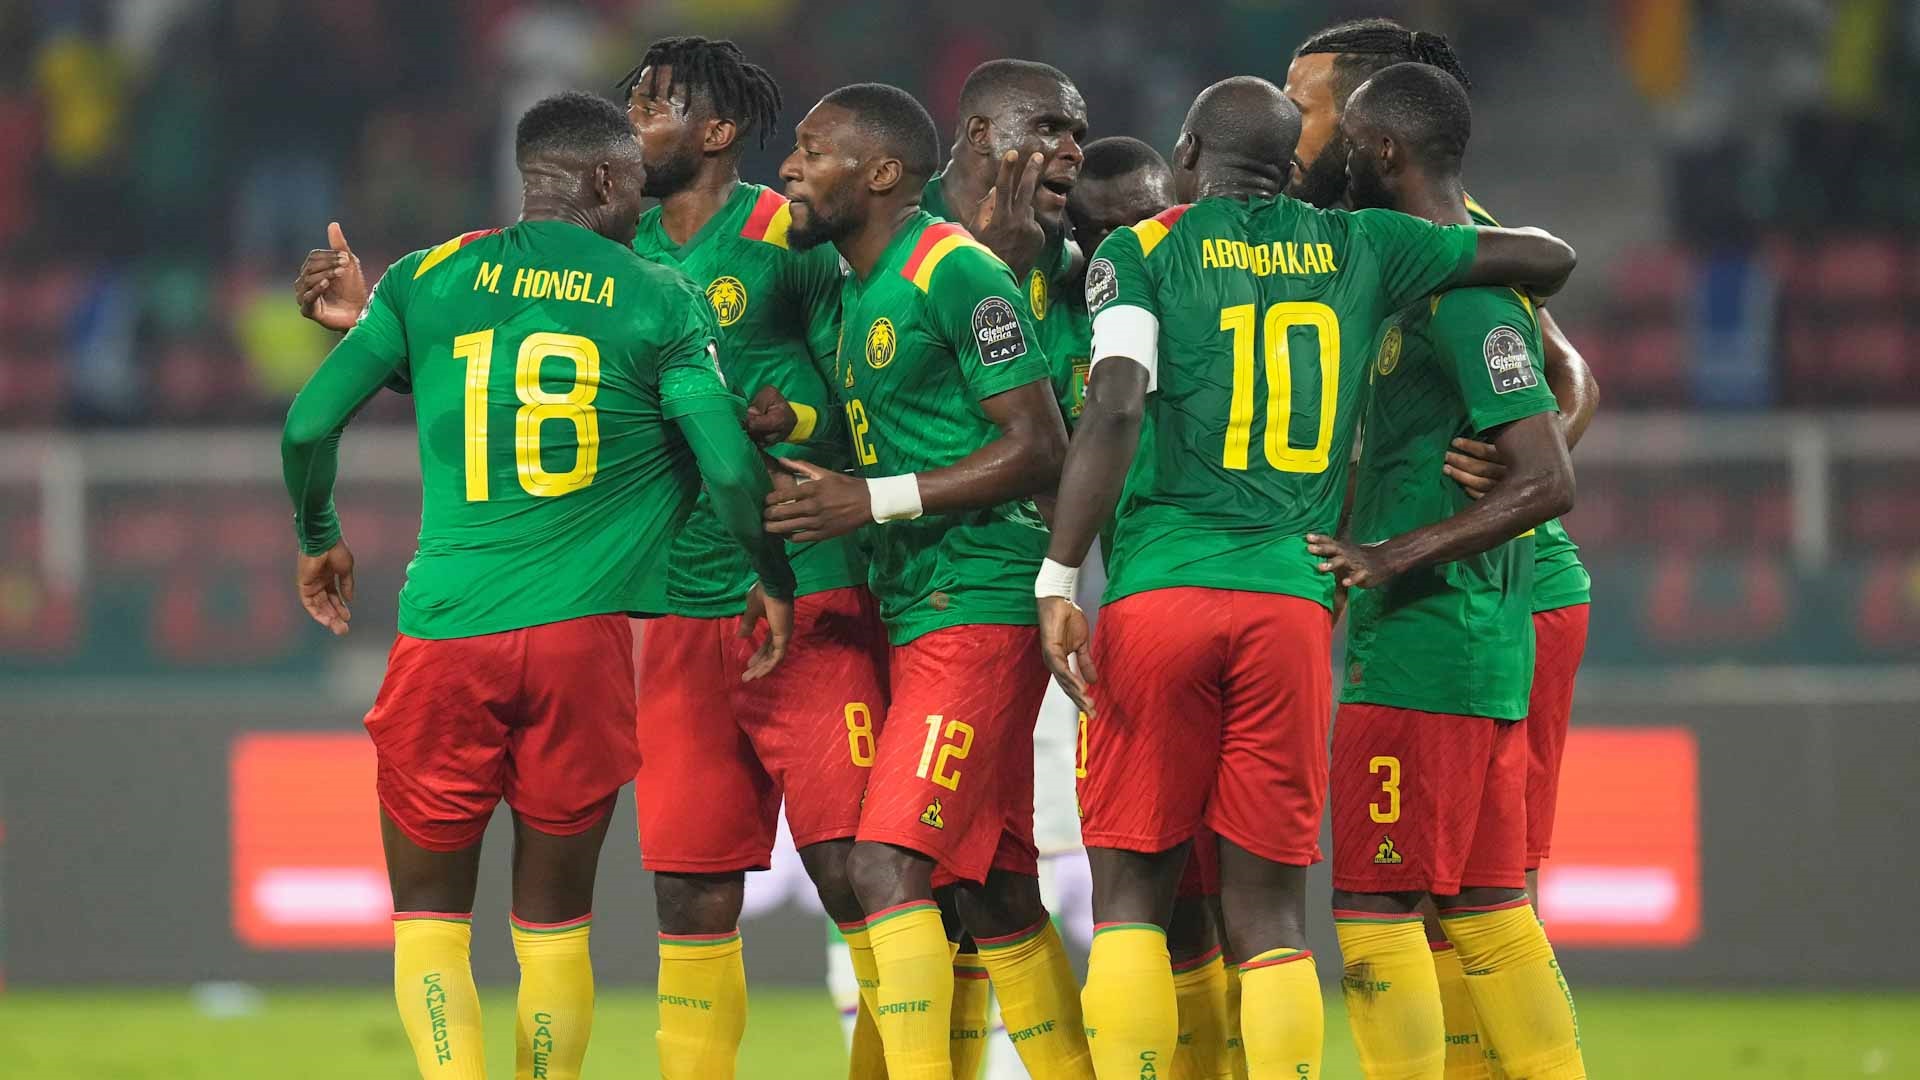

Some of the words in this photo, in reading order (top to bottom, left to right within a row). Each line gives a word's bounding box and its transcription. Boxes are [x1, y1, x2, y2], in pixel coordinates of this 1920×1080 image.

[473, 261, 503, 294] M.
[512, 267, 615, 307] HONGLA
[990, 344, 1017, 358] CAF
[1502, 375, 1529, 387] CAF
[453, 329, 600, 502] 18
[1220, 302, 1341, 473] 10
[845, 399, 878, 467] 12
[844, 702, 876, 767] 8
[916, 714, 974, 792] 12
[1369, 756, 1401, 823] 3
[423, 972, 452, 1066] CAMEROUN
[656, 994, 712, 1011] PORTIF
